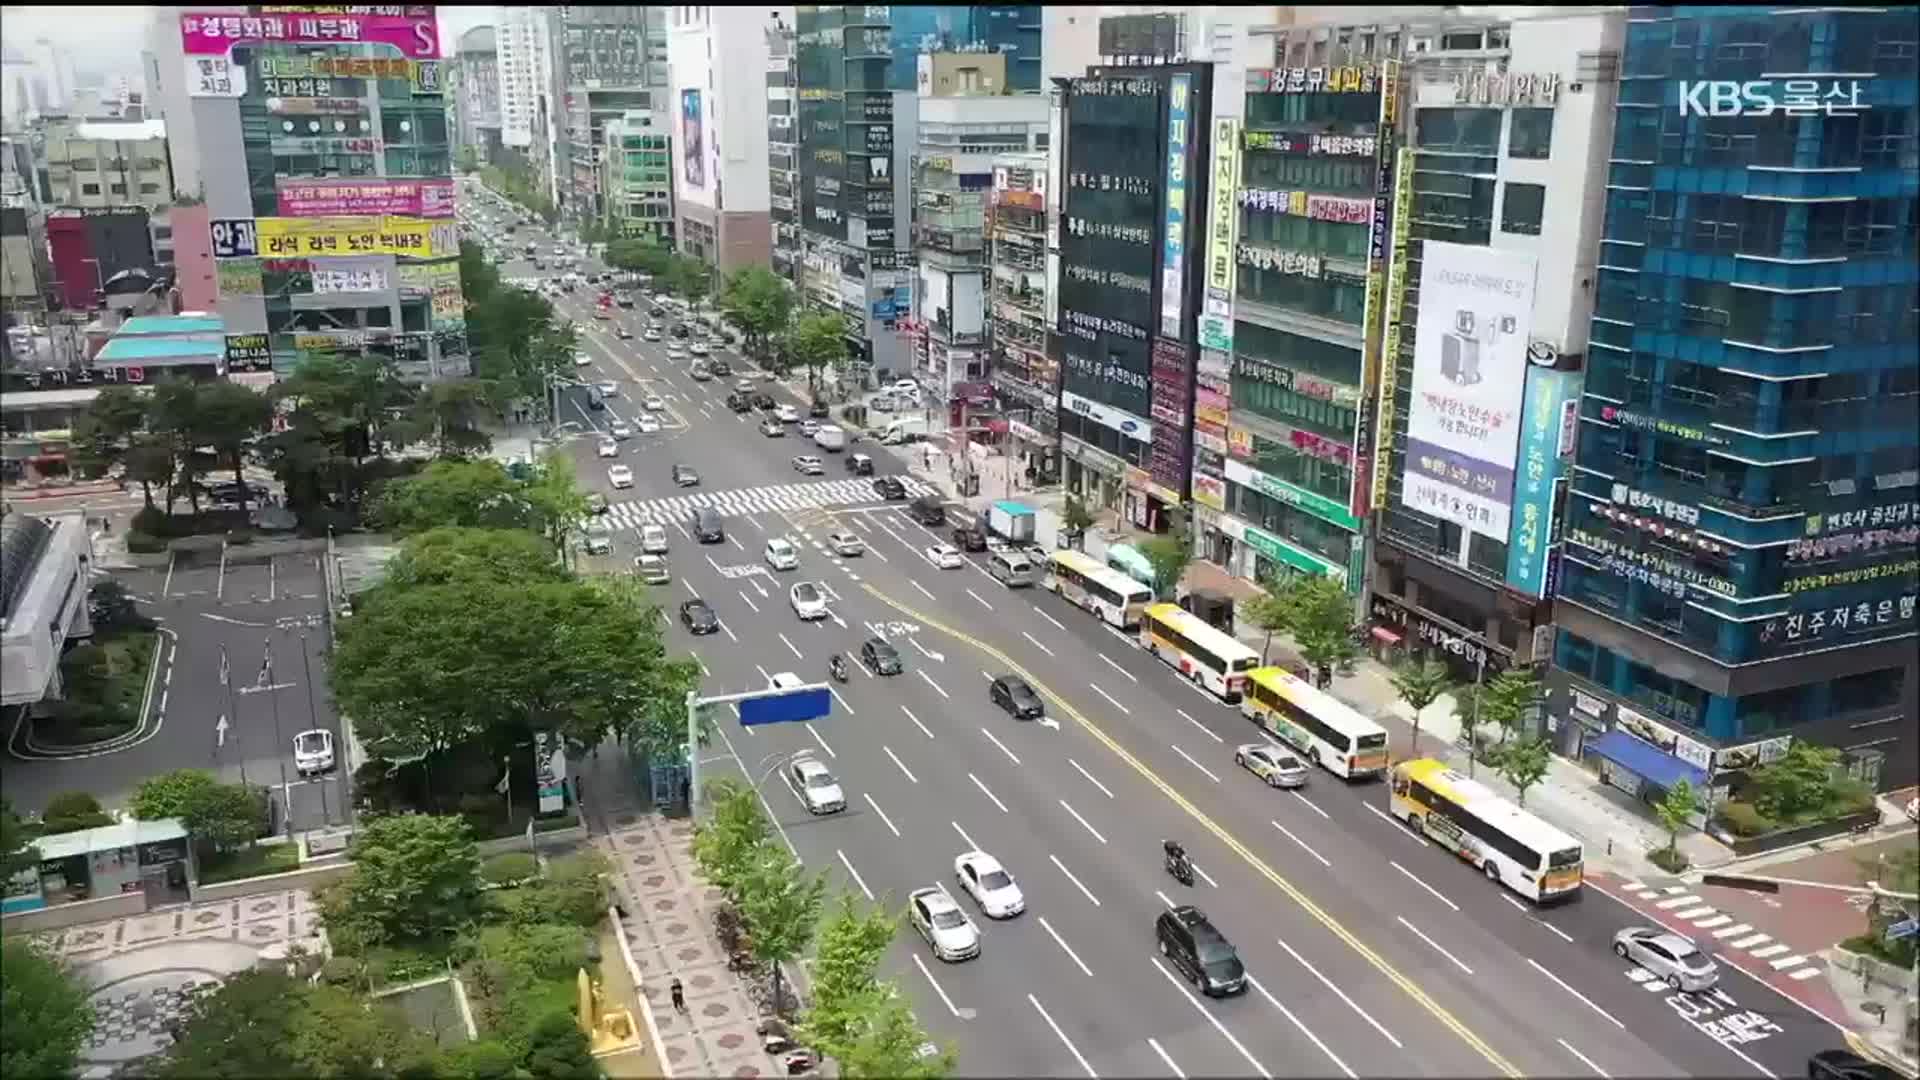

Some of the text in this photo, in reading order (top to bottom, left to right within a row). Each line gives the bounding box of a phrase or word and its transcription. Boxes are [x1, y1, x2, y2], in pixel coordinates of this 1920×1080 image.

[299, 18, 360, 40] 피부과
[213, 221, 256, 255] 안과
[269, 237, 299, 253] 라식
[347, 234, 375, 250] 노안
[1827, 508, 1867, 531] 변호사
[1784, 594, 1918, 640] 진주저축은행
